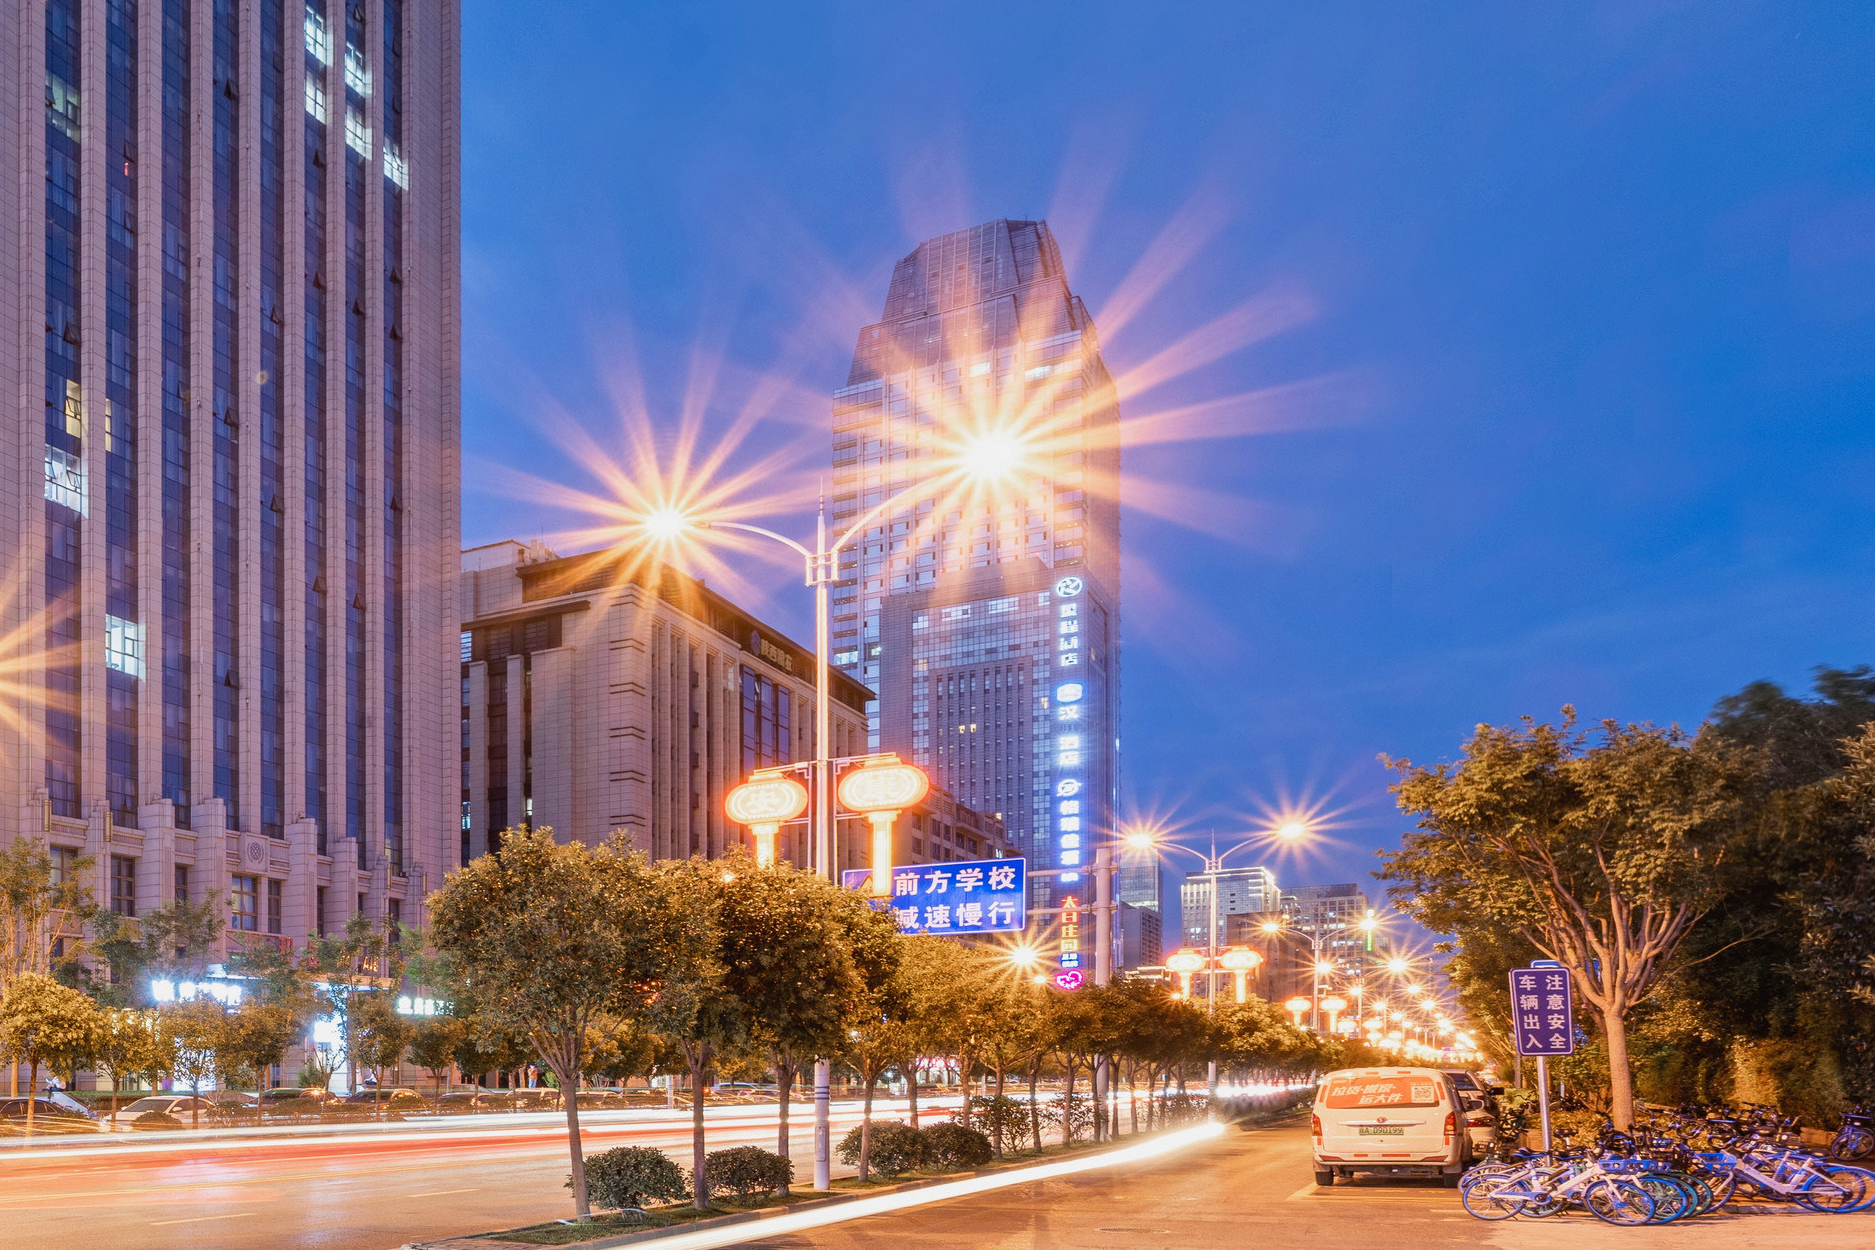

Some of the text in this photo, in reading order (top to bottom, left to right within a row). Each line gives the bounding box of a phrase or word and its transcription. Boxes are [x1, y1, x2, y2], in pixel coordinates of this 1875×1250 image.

[894, 865, 1016, 896] 前方学校
[897, 900, 1016, 929] 减速慢行
[1518, 974, 1543, 1049] 车辆出入
[1545, 974, 1567, 1049] 注意安全
[1358, 1093, 1404, 1105] 运大件
